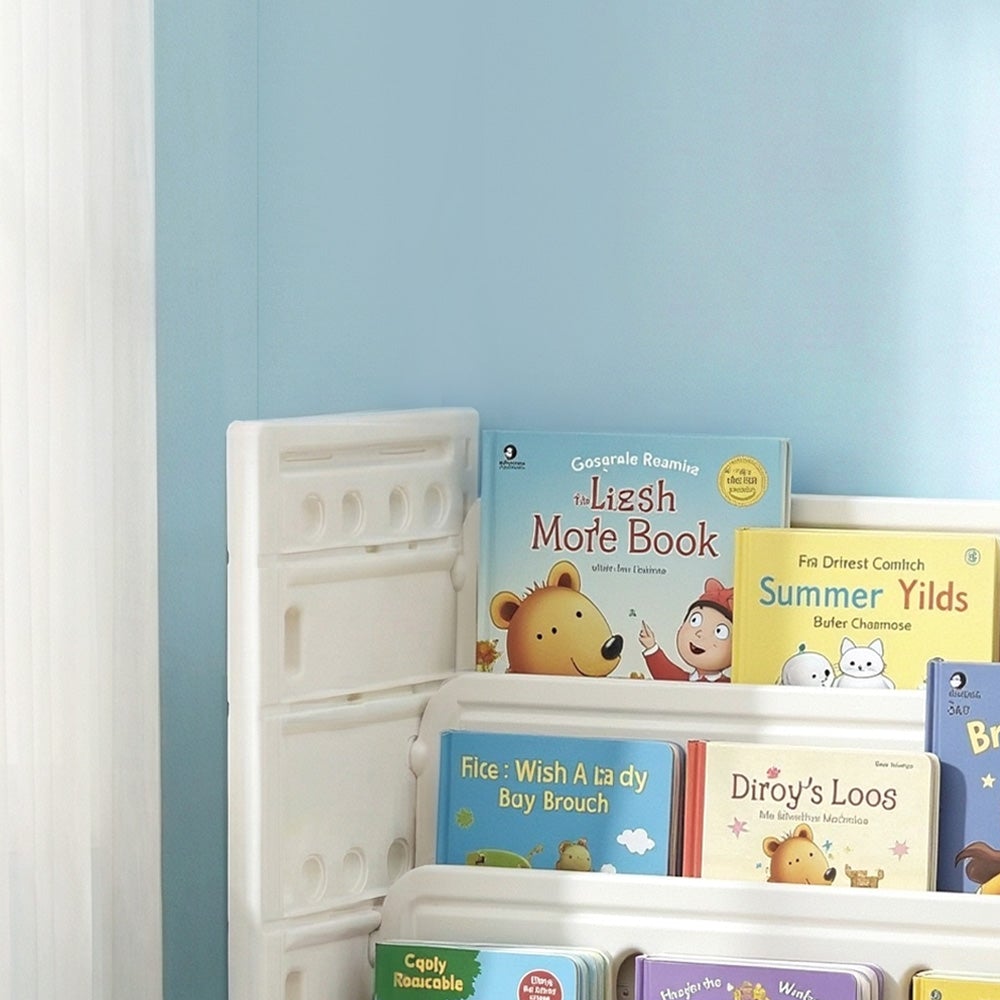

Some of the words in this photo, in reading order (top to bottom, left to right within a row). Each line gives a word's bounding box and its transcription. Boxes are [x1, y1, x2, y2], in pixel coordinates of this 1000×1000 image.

[627, 518, 719, 558] Book
[759, 576, 883, 609] Summer
[898, 579, 968, 612] Yilds
[515, 759, 567, 785] Wish
[573, 762, 588, 785] A
[499, 787, 535, 814] Bay
[543, 790, 609, 813] Brouch
[831, 778, 897, 811] Loos
